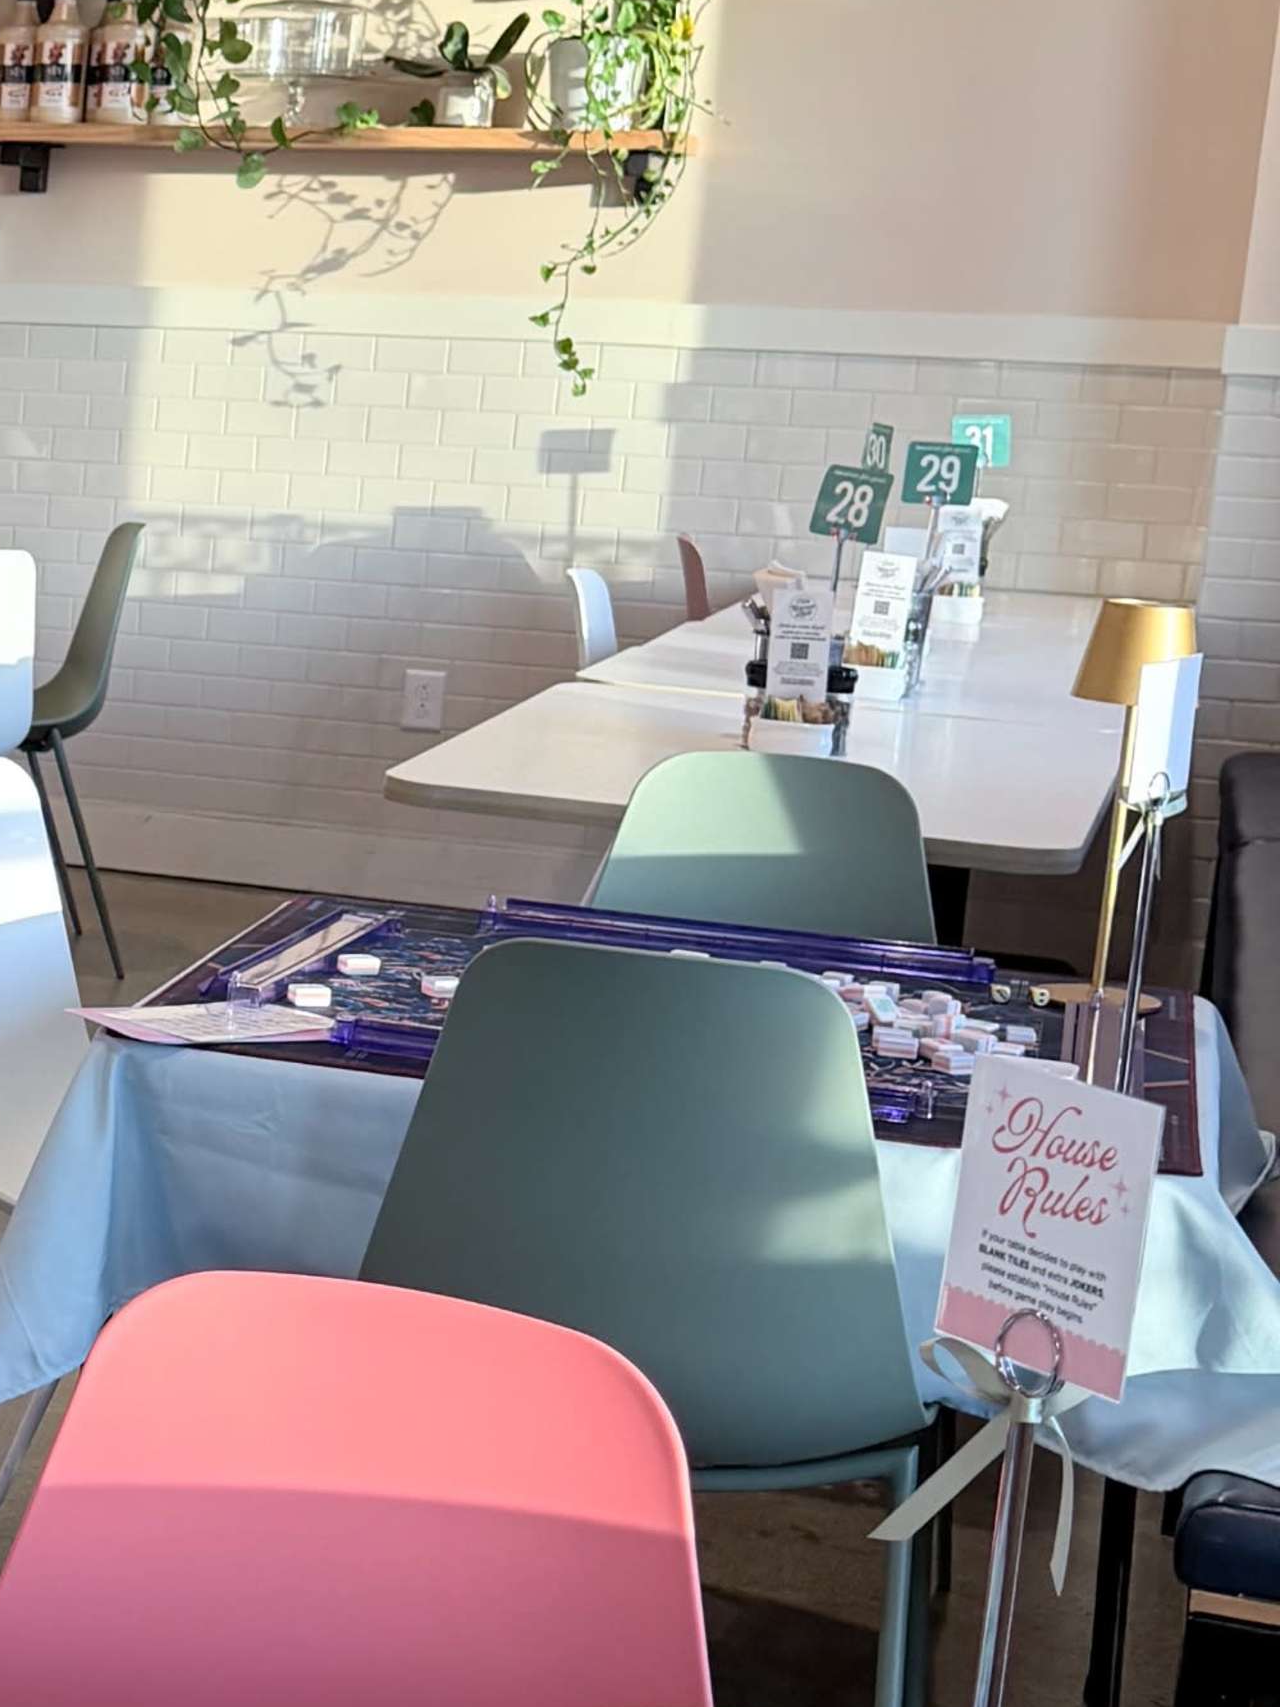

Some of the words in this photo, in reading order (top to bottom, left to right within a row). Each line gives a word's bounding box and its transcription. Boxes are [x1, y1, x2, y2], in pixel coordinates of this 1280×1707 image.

[865, 433, 887, 470] 30
[915, 453, 962, 494] 29
[825, 480, 875, 529] 28
[992, 1097, 1121, 1172] House
[999, 1157, 1112, 1239] Rules
[988, 1234, 1006, 1245] your
[979, 1243, 1007, 1261] BLANK
[1007, 1254, 1030, 1270] TILES
[1031, 1265, 1046, 1277] and
[1047, 1271, 1069, 1285] extra
[981, 1262, 1006, 1277] please
[1006, 1272, 1041, 1290] establish
[988, 1280, 1013, 1297] before
[1014, 1292, 1037, 1305] game
